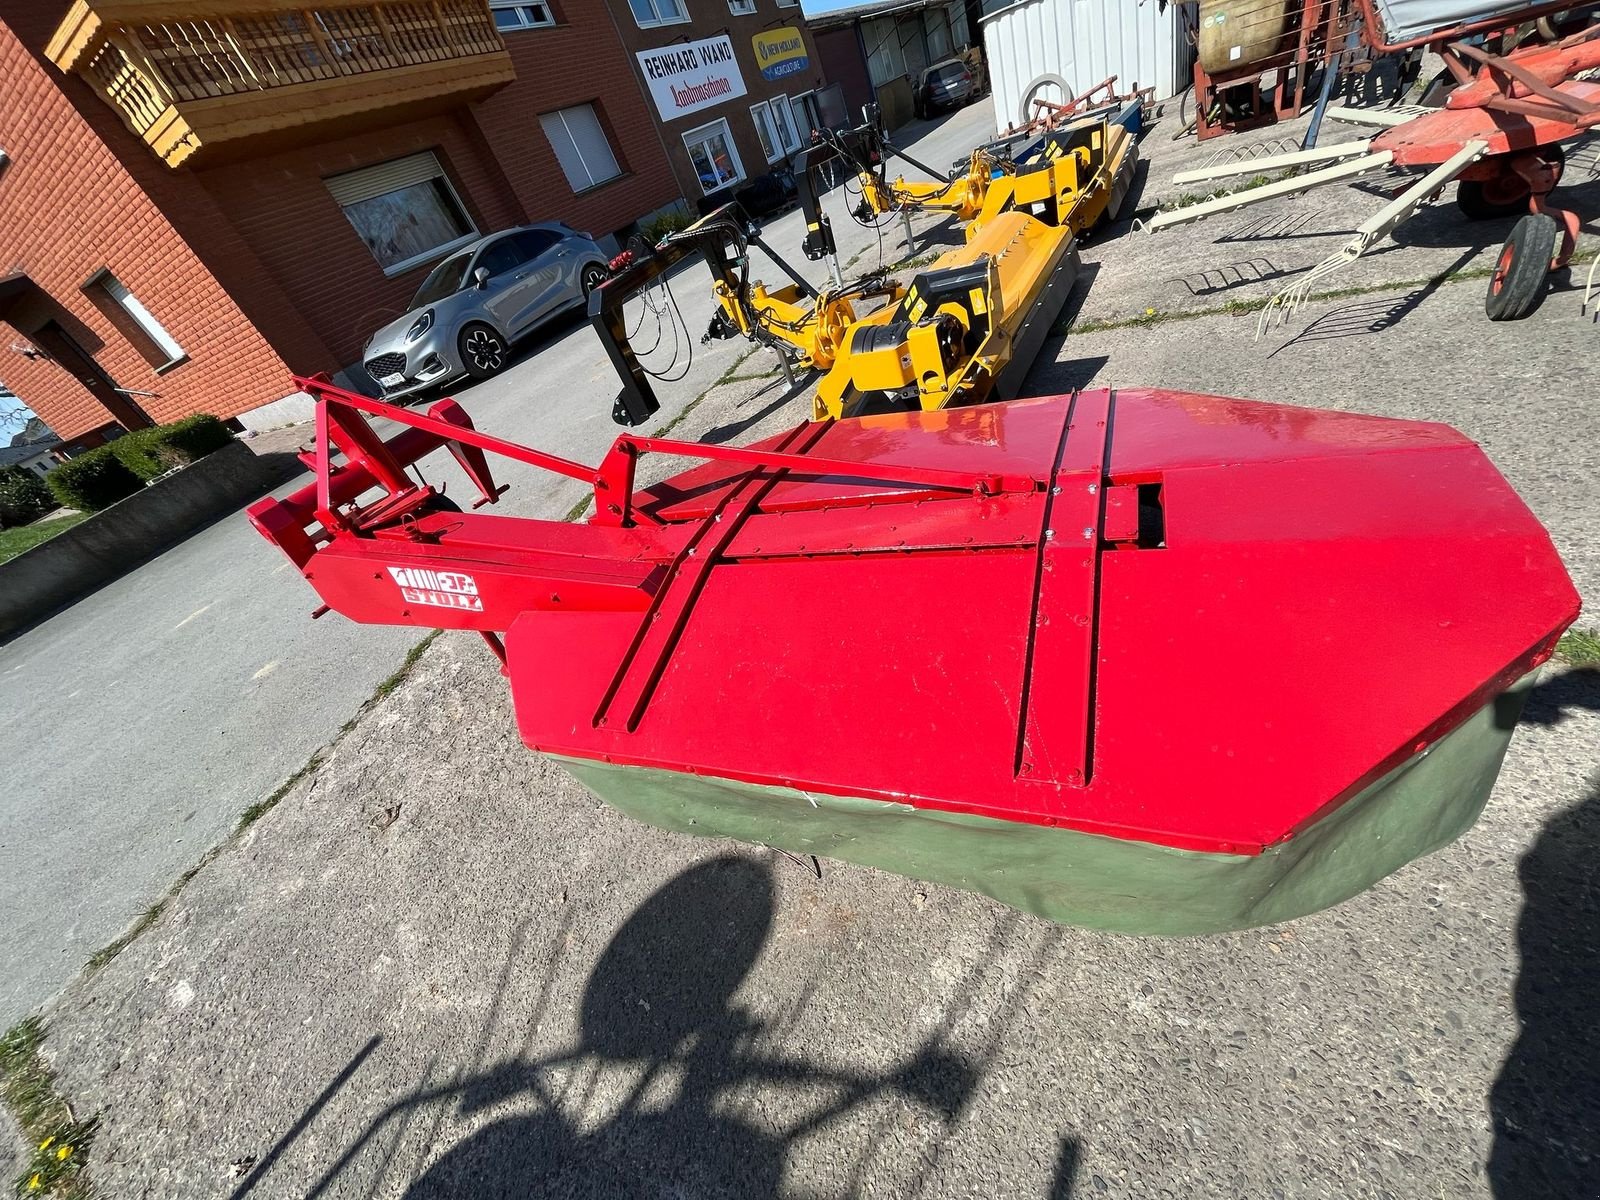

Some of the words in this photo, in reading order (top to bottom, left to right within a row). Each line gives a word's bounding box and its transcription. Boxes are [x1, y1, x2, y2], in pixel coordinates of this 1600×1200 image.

[644, 49, 698, 80] REINHARD
[698, 42, 732, 67] WAND
[774, 60, 801, 76] AGRICULTURE
[669, 75, 732, 108] Landmaschinen
